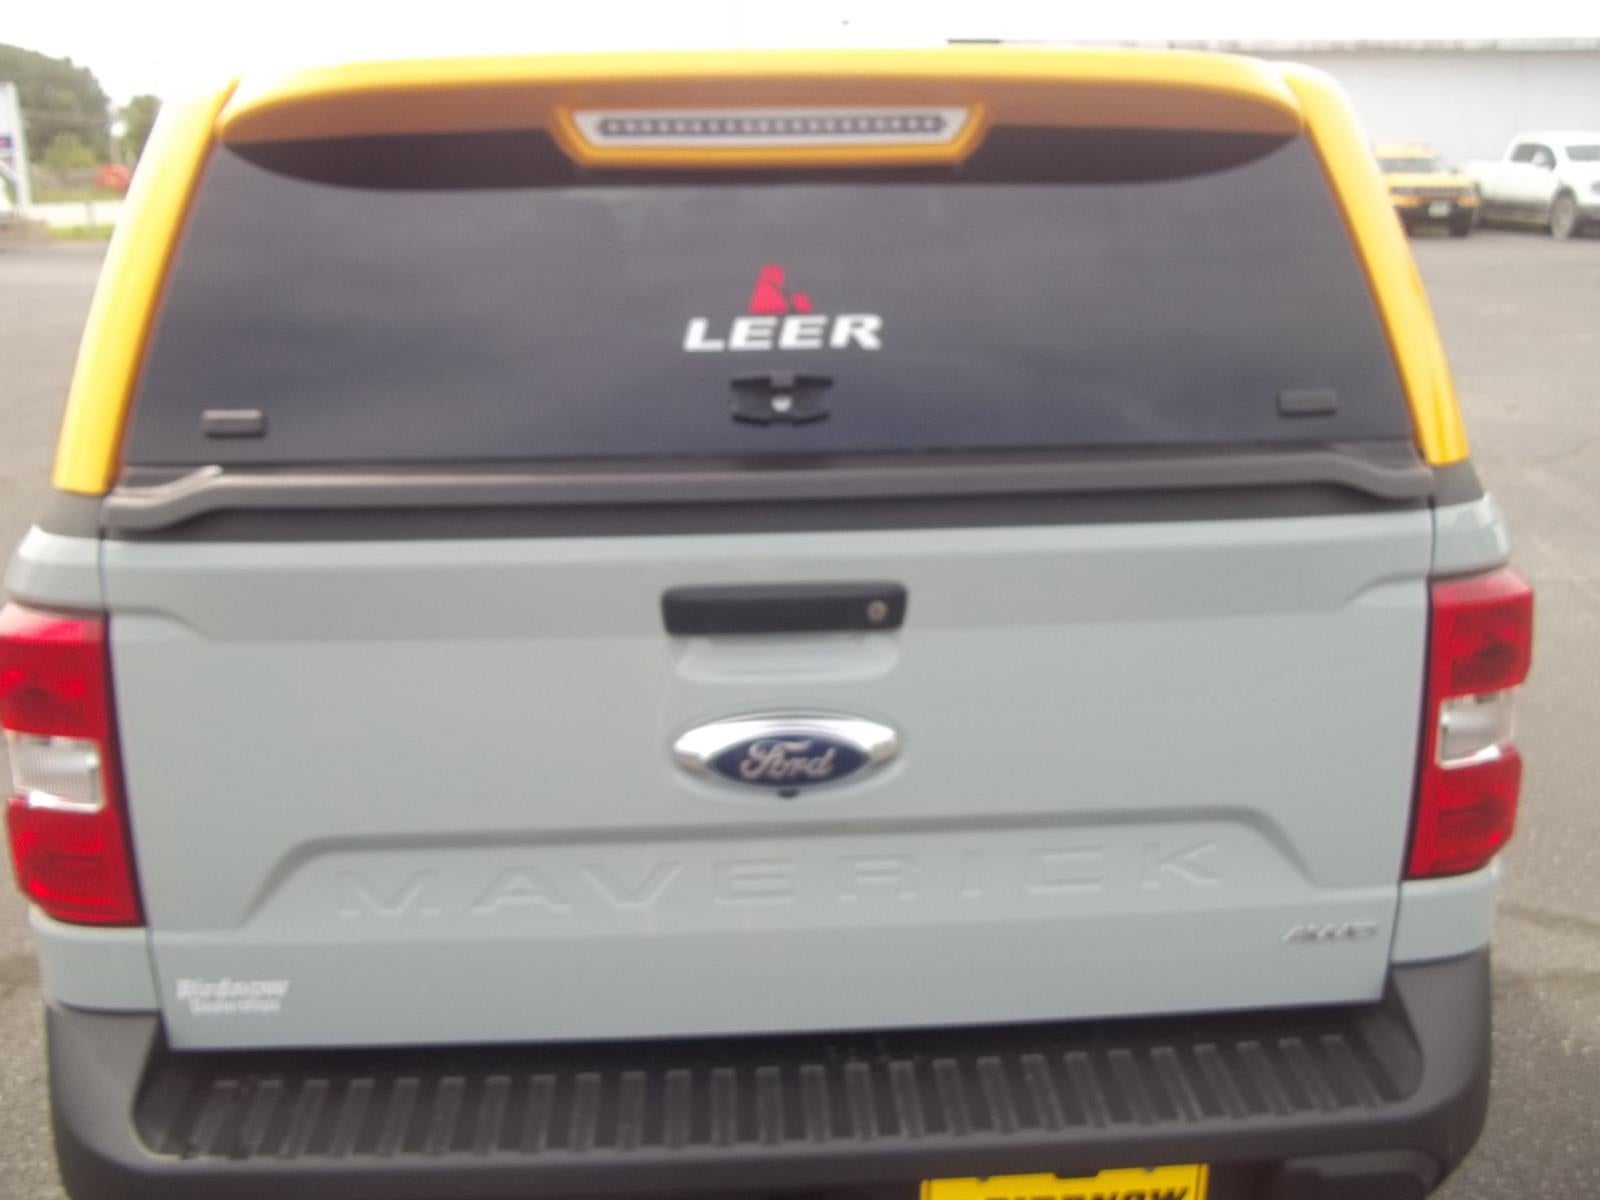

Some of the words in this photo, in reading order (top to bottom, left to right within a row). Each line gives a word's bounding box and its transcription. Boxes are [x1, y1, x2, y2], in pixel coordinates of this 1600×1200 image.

[683, 313, 882, 352] LEER
[739, 740, 836, 779] Ford
[338, 840, 1223, 918] MAVERICK
